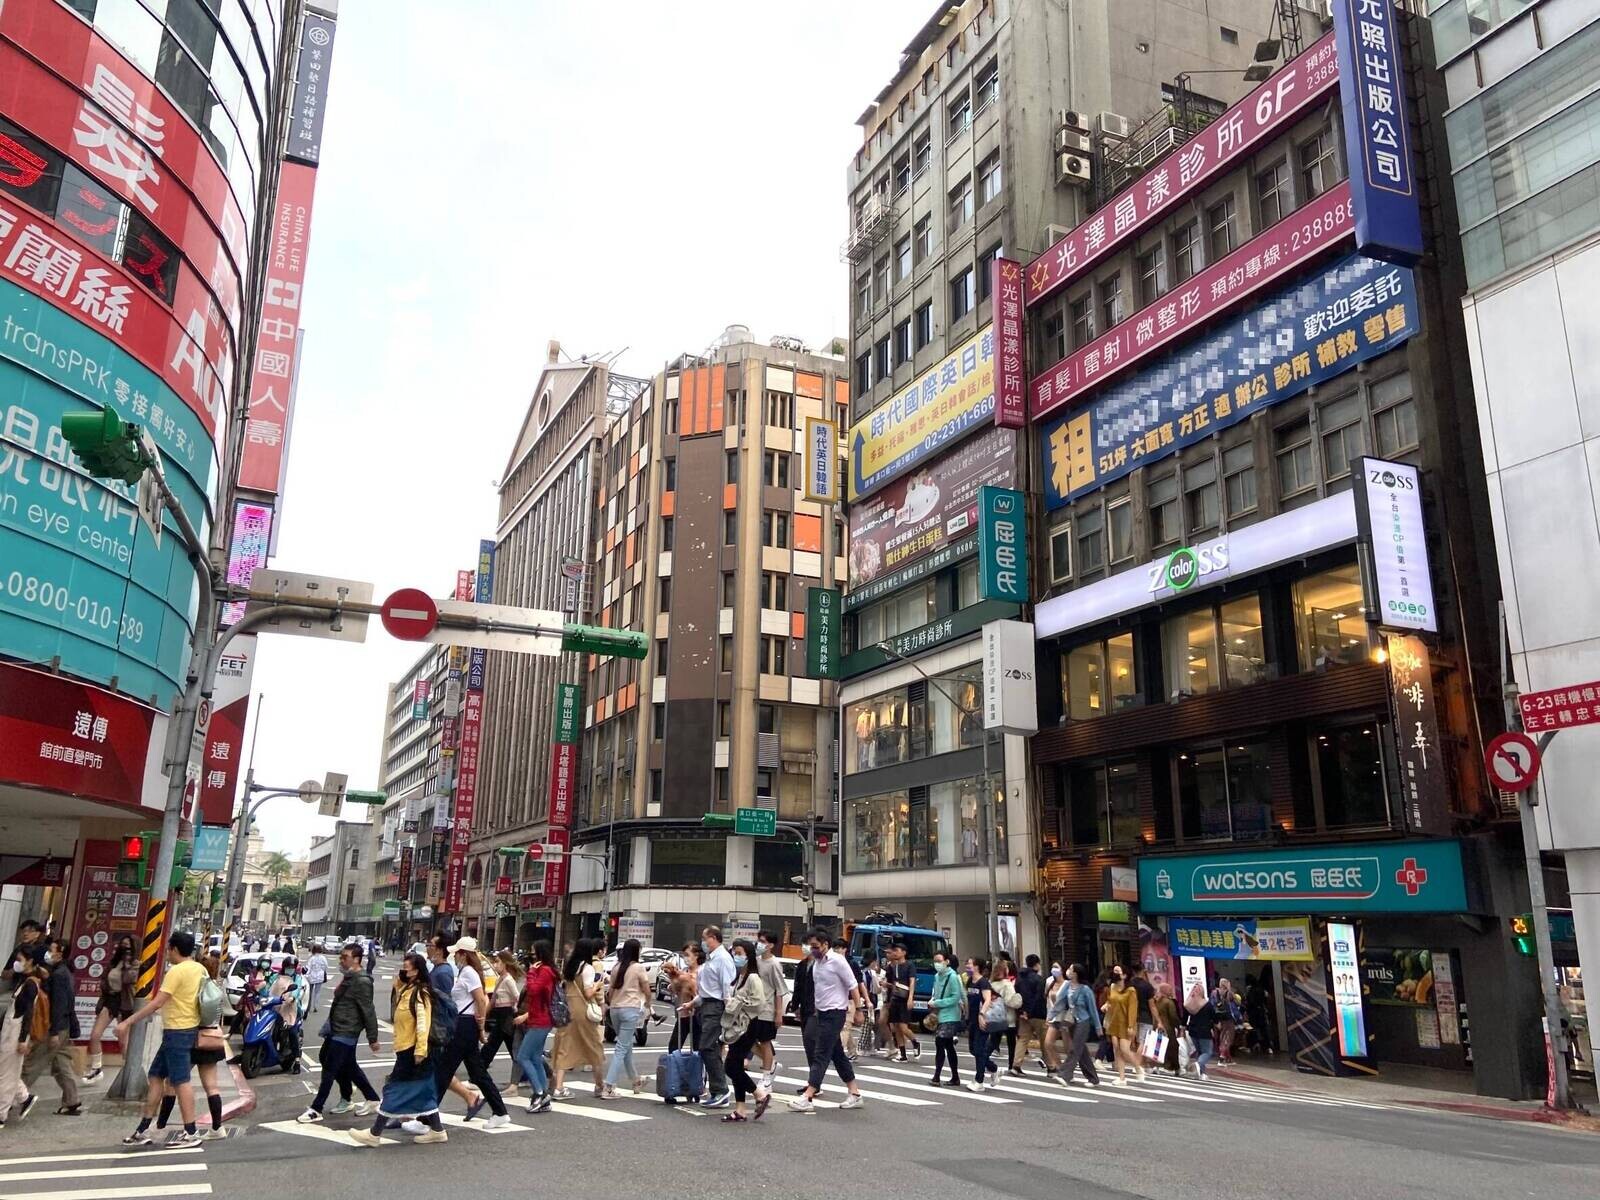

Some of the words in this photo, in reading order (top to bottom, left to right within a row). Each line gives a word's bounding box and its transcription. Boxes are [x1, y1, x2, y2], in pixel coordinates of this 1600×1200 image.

[1056, 110, 1244, 277] 光澤晶漾診所
[1255, 70, 1296, 125] 6F
[275, 203, 291, 269] INSURANCE
[294, 206, 305, 241] CHINA
[289, 243, 301, 272] LIFE
[1304, 268, 1402, 340] 歡迎委託
[4, 316, 111, 394] transPRK
[1002, 284, 1020, 391] 光澤晶漾診所
[247, 317, 294, 447] 中國人壽
[1005, 394, 1021, 407] 6F
[1099, 446, 1127, 473] 51坪
[1179, 406, 1208, 437] 方正
[1235, 374, 1268, 409] 辦公
[1273, 352, 1310, 390] 診所
[1316, 329, 1358, 367] 補教
[1364, 304, 1405, 342] 零售
[816, 426, 827, 495] 時代英日韓語
[1050, 411, 1095, 498] 租
[28, 504, 70, 533] eye
[995, 520, 1017, 594] 屈臣氏
[1170, 559, 1193, 578] color
[903, 619, 952, 652] 美力時尚診所
[221, 658, 247, 669] FET
[72, 710, 109, 744] 遠傳
[467, 695, 480, 721] 高點
[562, 687, 574, 729] 智勝出版
[39, 742, 103, 769] 館前直營門市
[208, 742, 231, 789] 遠傳
[556, 745, 569, 811] 貝塔語言出版
[1203, 869, 1298, 890] watsons
[1310, 867, 1363, 888] 屈臣氏
[1259, 936, 1304, 951] 第2件5折
